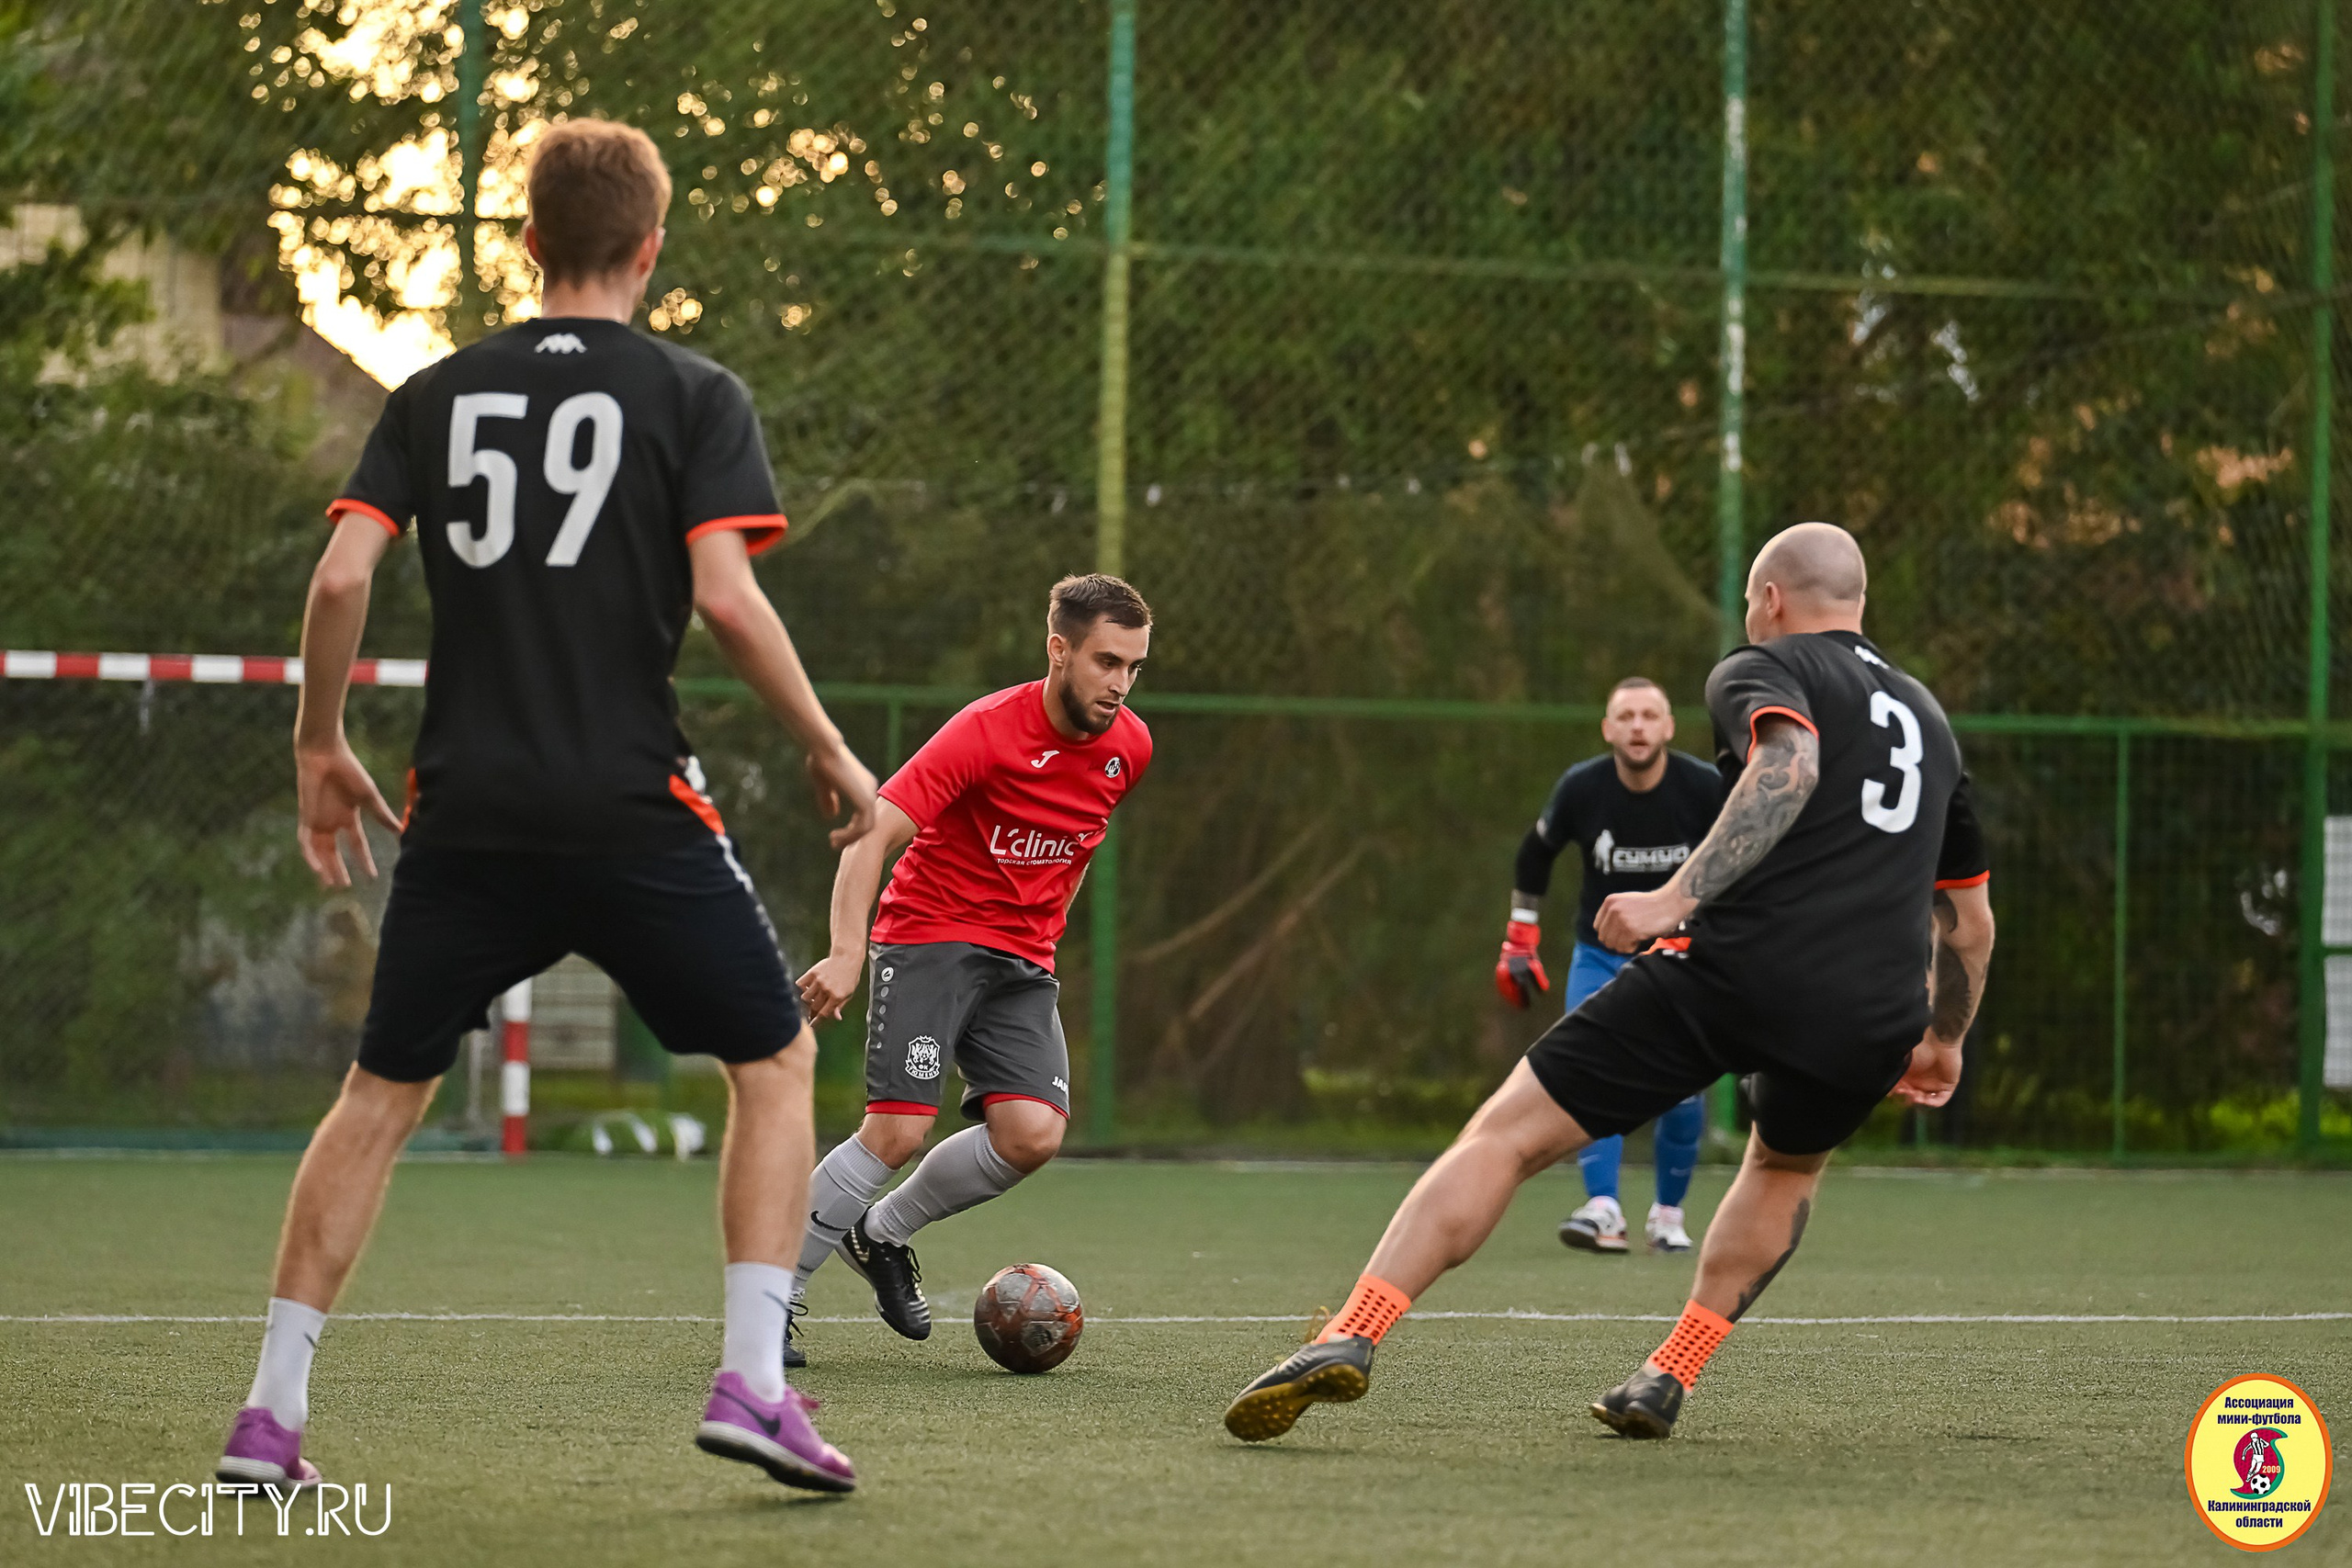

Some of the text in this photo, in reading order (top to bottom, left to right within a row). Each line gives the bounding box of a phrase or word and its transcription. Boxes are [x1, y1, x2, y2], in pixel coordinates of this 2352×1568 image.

[446, 391, 624, 570] 59
[1861, 691, 1924, 833] 3
[1052, 1076, 1069, 1092] JAK
